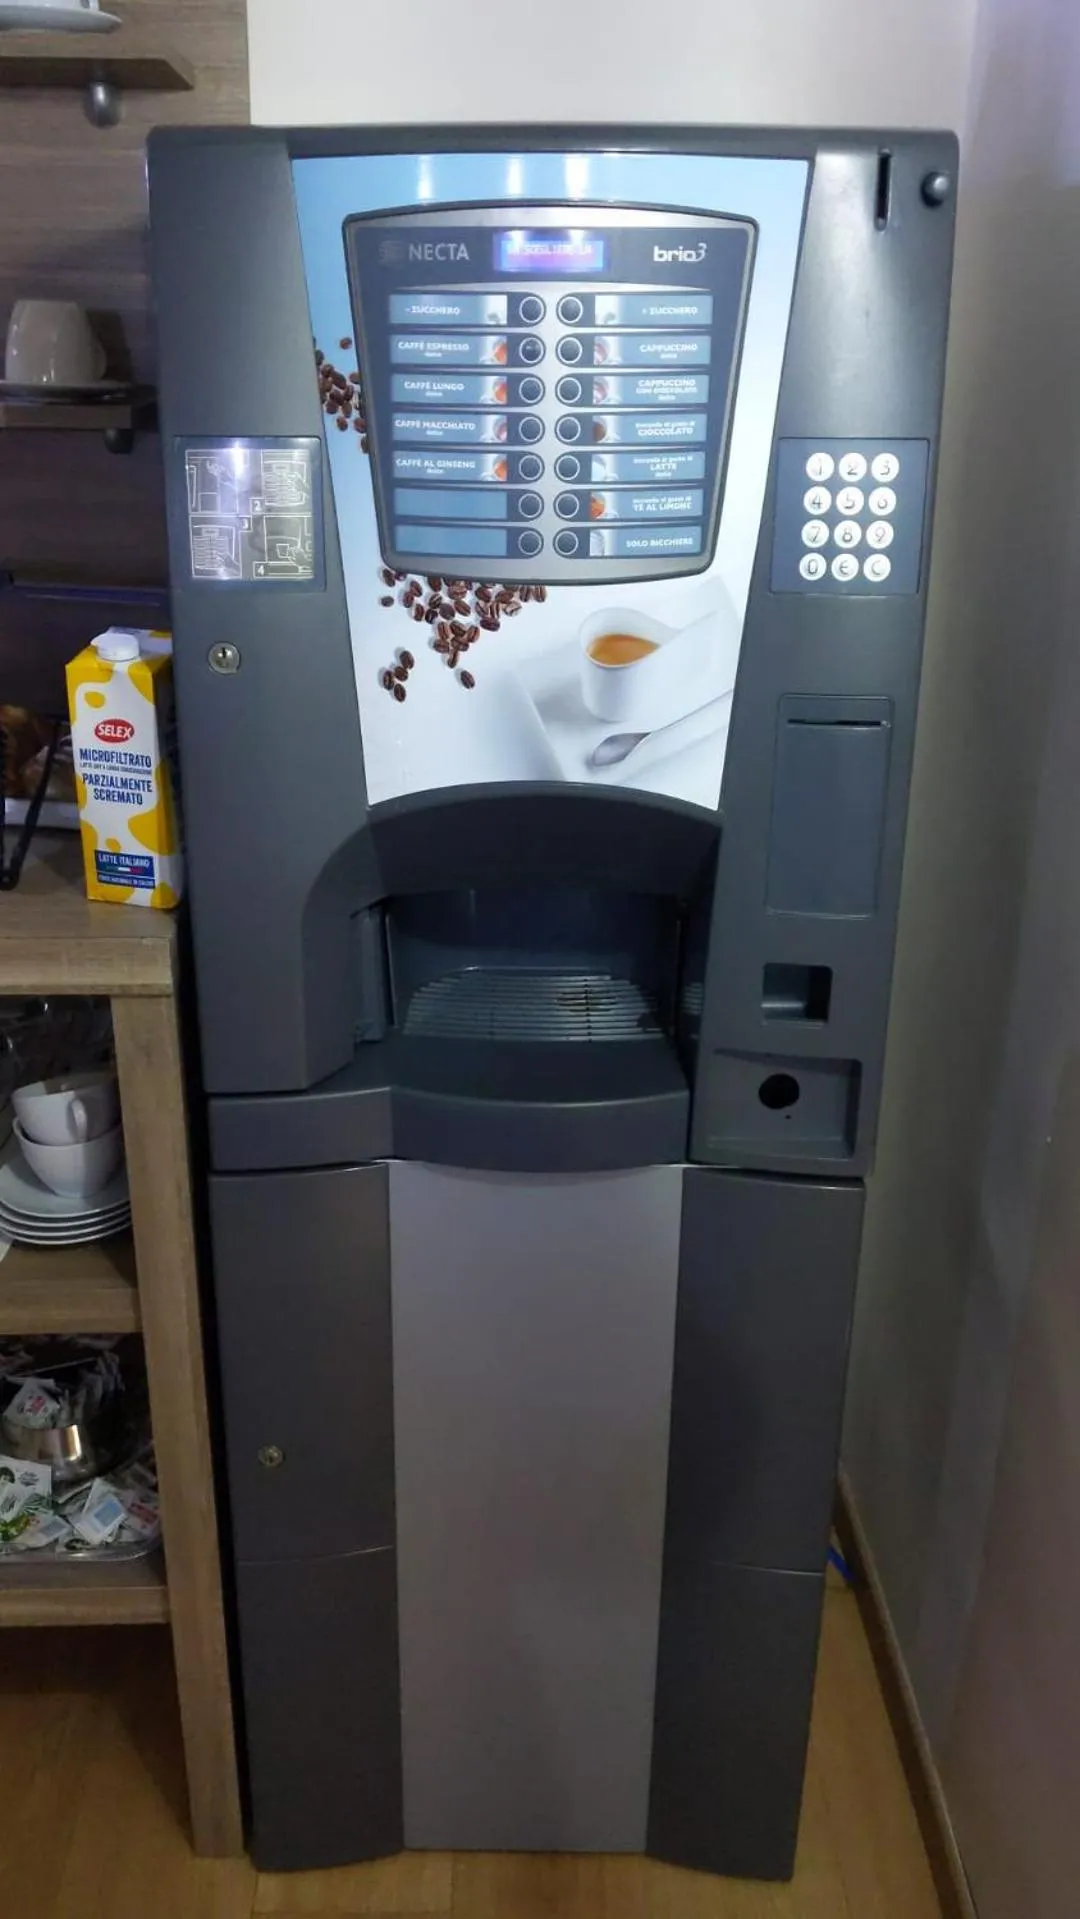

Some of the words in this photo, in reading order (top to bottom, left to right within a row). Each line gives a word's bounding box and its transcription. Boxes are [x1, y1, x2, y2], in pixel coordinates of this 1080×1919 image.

[408, 243, 470, 261] NECTA
[411, 305, 461, 315] ZUCCHERO
[649, 306, 698, 315] ZUCCHERO
[426, 342, 470, 351] ESPRESSO
[639, 343, 698, 353] CAPPUCCINO
[432, 382, 465, 391] LUNGO
[638, 379, 696, 387] CAPPUCCINO
[422, 420, 476, 430] MACCHIATO
[638, 427, 693, 437] CIOCCOLATO
[424, 459, 435, 467] AL
[436, 460, 476, 469] GINSENG
[650, 463, 678, 471] LATTE
[847, 459, 858, 476] 2
[879, 460, 891, 476] 3
[253, 500, 263, 511] 2
[659, 501, 692, 511] LIMONE
[811, 493, 823, 510] 4
[843, 492, 856, 510] 5
[877, 493, 888, 510] 6
[810, 525, 821, 543] 7
[842, 525, 853, 543] 8
[875, 526, 886, 544] 9
[626, 539, 649, 548] SOLO
[650, 537, 693, 547] BICCHIERE
[257, 565, 265, 576] 4
[871, 559, 881, 576] C
[97, 723, 133, 739] SELEX
[79, 748, 152, 768] MICROFILTRATO
[82, 773, 153, 793] PARZIALMENTE
[93, 788, 143, 805] SCREMATO
[98, 853, 118, 865] LATTE
[119, 856, 151, 867] ITALIANO
